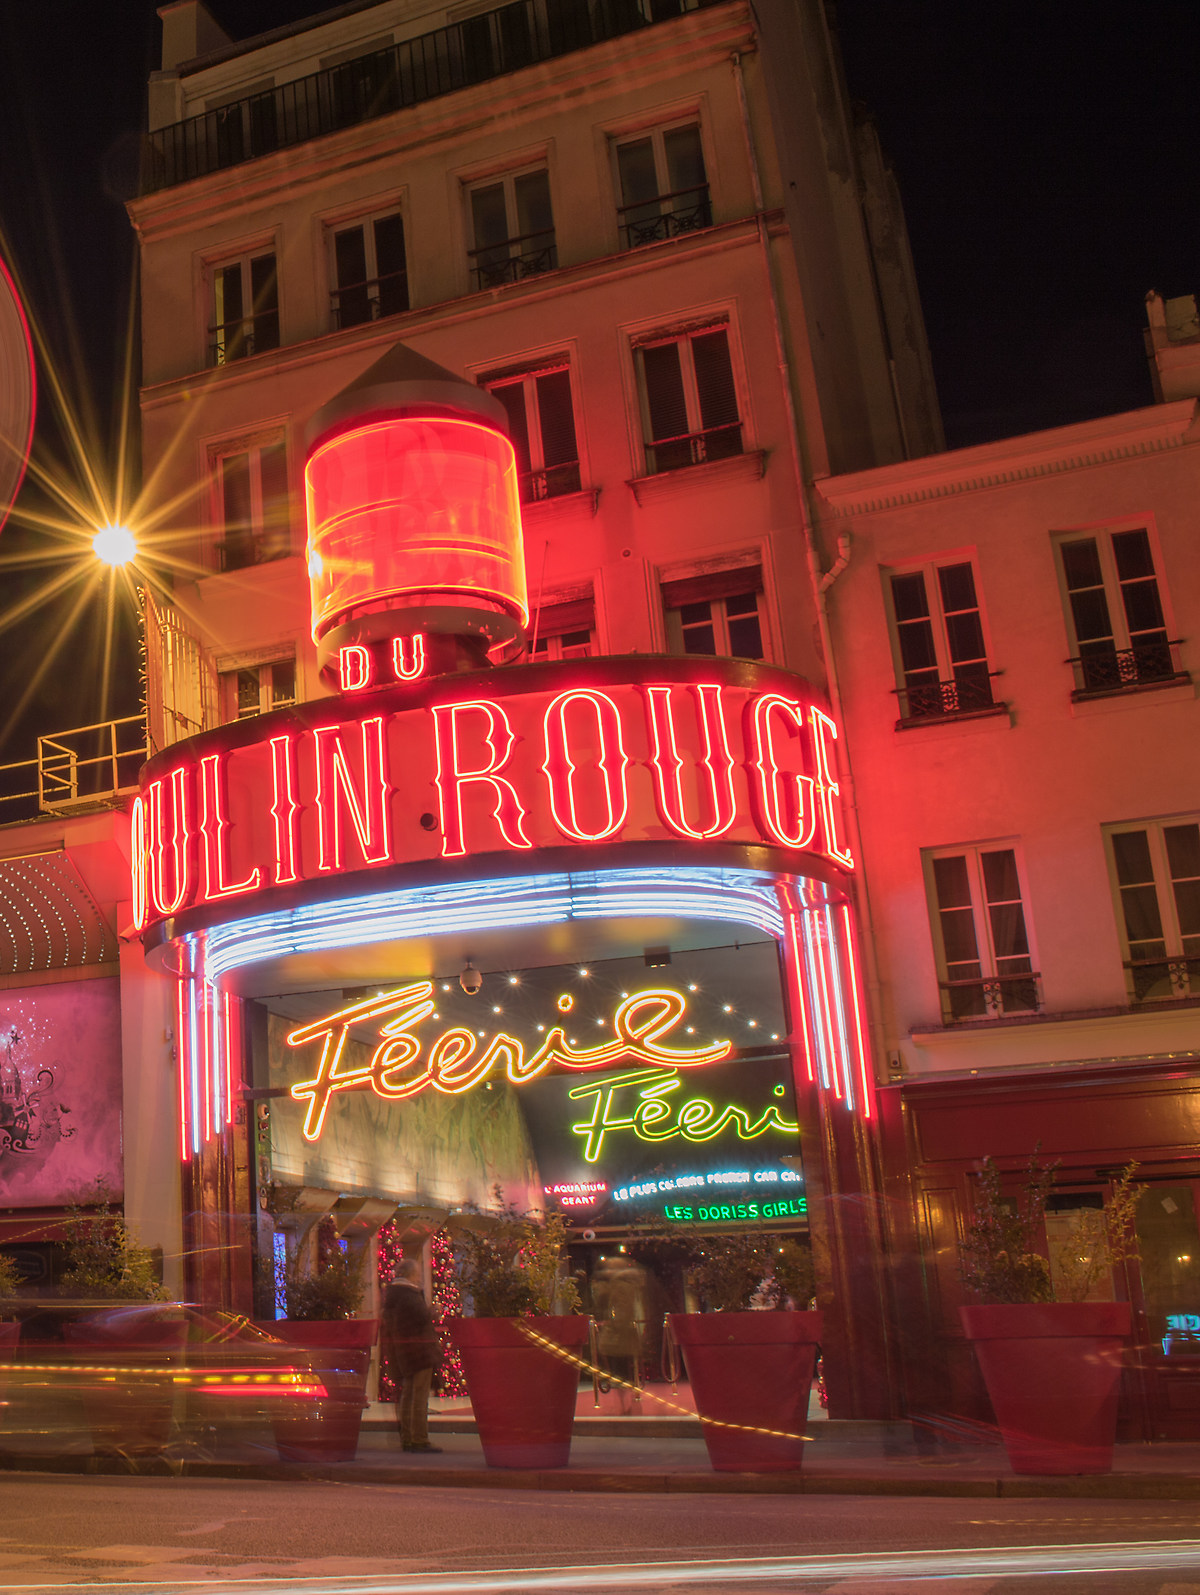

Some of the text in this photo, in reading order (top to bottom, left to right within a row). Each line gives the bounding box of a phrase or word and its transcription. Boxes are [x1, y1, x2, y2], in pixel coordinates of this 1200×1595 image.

[340, 633, 428, 691] DU
[430, 683, 855, 870] ROUGE
[286, 980, 734, 1142] Féerie
[629, 1182, 658, 1198] PLUS
[664, 1197, 807, 1221] LES DORISS GIRLS
